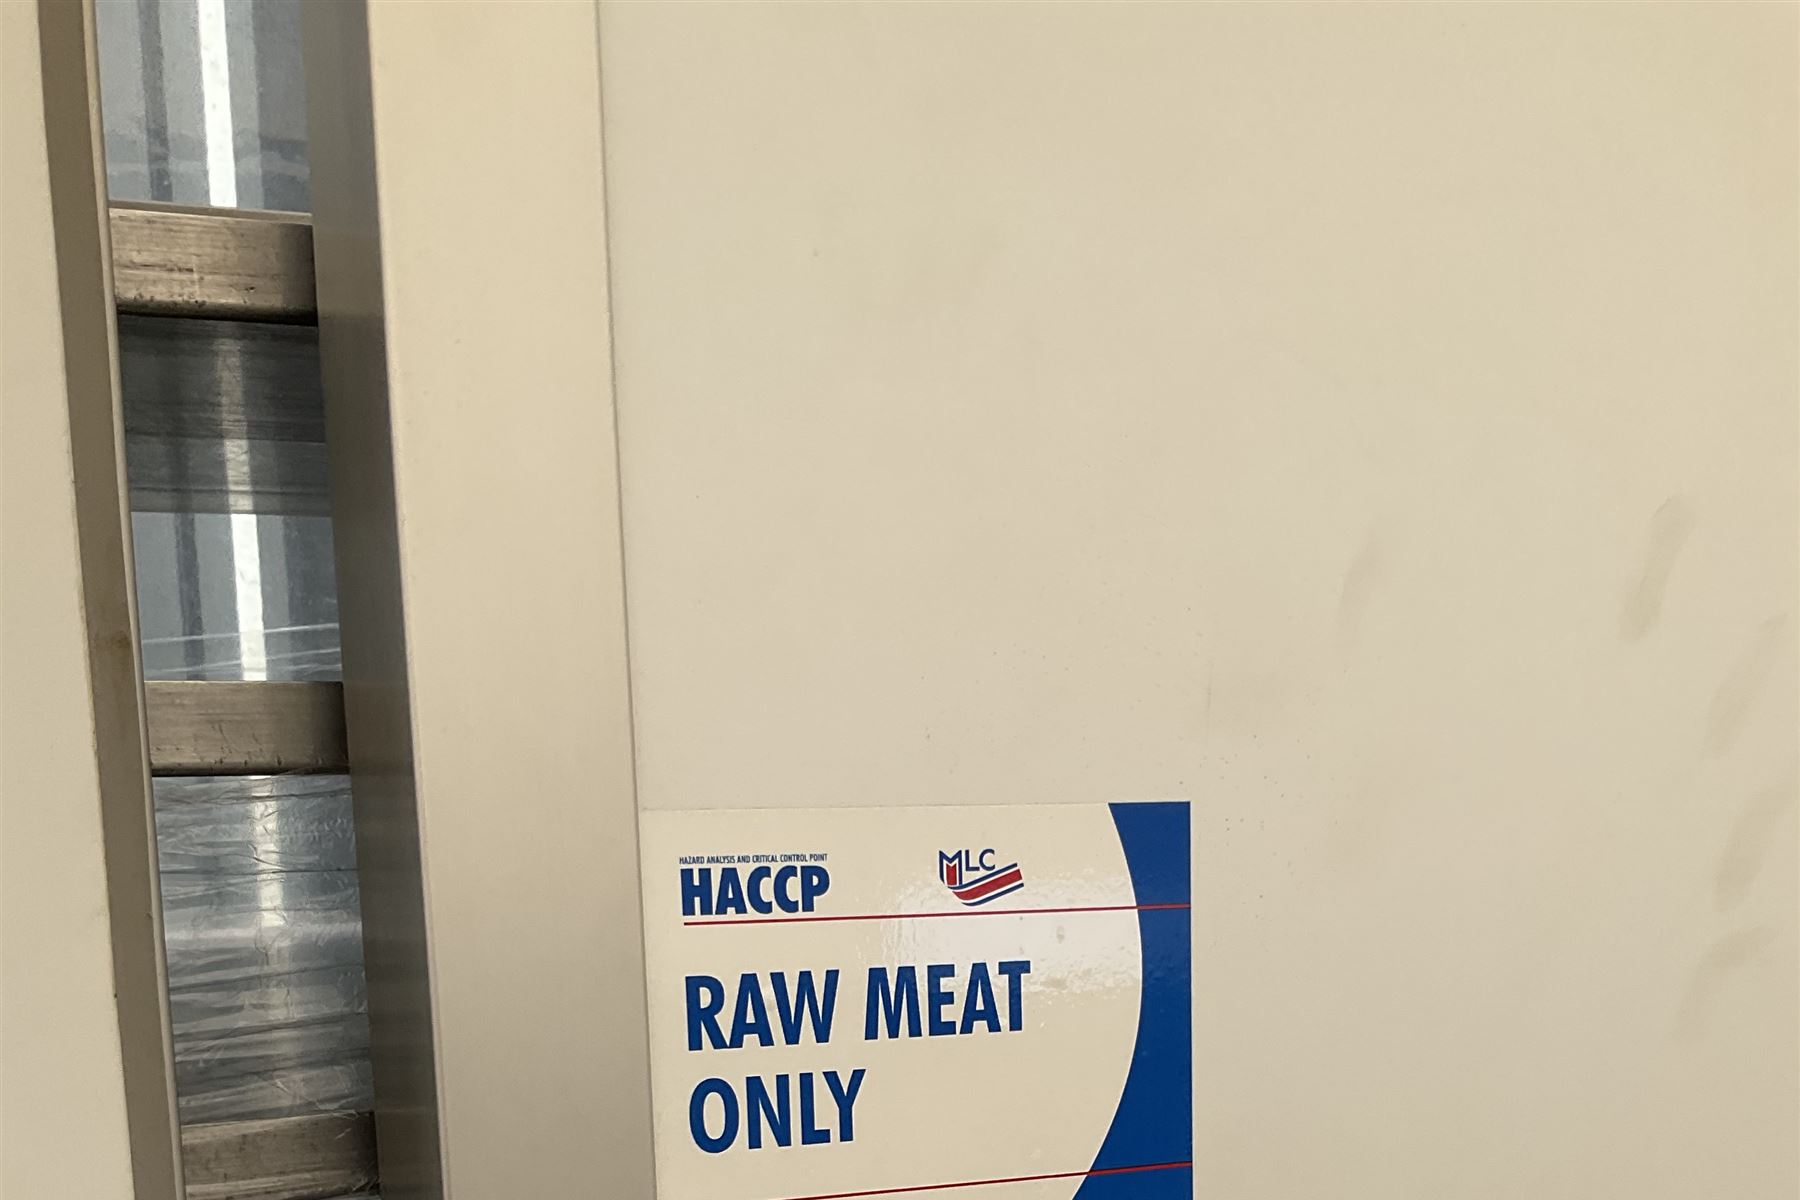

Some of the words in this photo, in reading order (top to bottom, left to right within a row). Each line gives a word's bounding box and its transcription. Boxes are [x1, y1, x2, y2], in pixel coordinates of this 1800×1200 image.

[679, 856, 705, 864] HAZARD
[706, 855, 736, 864] ANALYSIS
[737, 855, 751, 863] AND
[752, 854, 779, 863] CRITICAL
[780, 853, 808, 862] CONTROL
[809, 853, 828, 862] POINT
[938, 848, 996, 887] MLC
[680, 864, 830, 916] HACCP
[685, 968, 840, 1052] RAW
[864, 959, 1032, 1041] MEAT
[689, 1068, 867, 1154] ONLY
